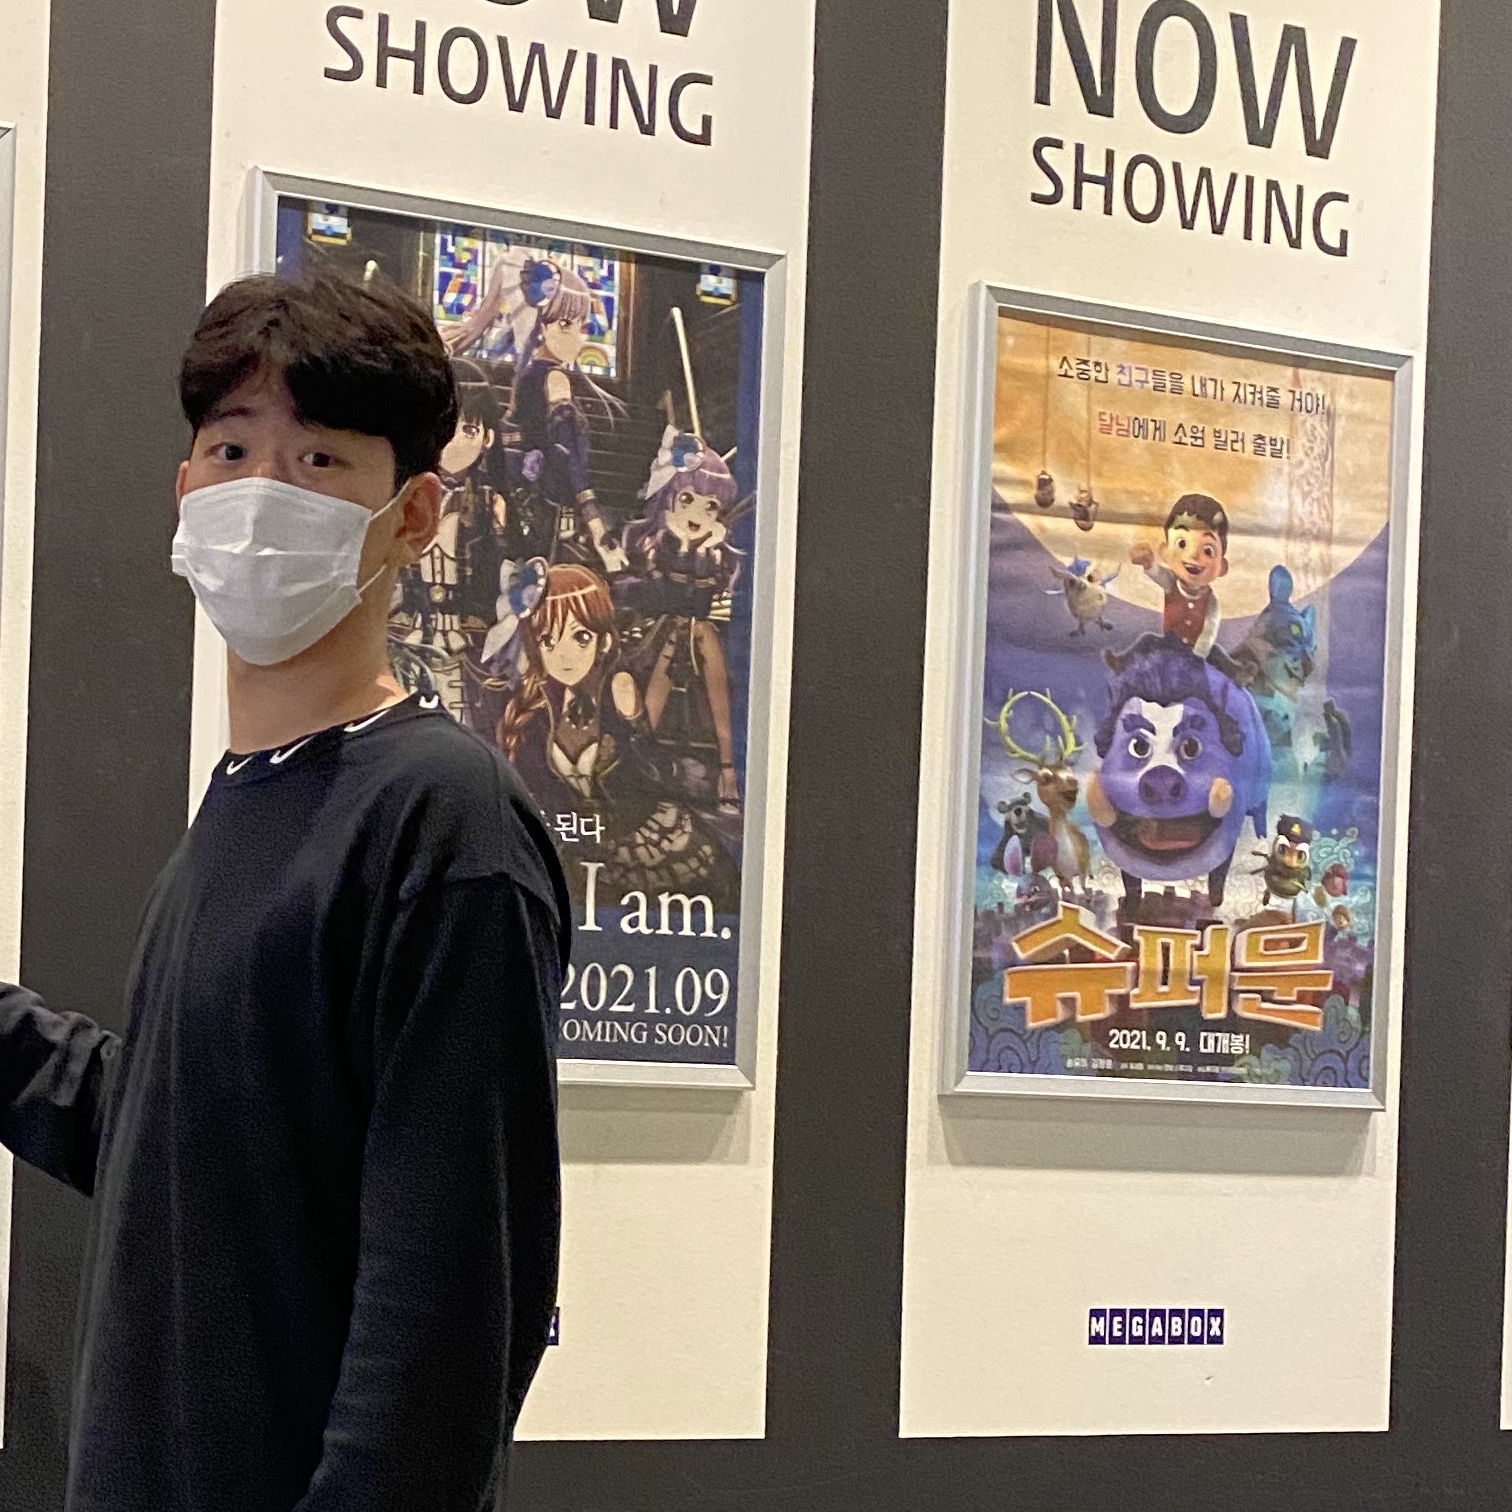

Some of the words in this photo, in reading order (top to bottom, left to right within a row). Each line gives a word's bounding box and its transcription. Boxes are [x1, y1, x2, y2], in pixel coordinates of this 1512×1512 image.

[324, 5, 714, 147] SHOWING
[1033, 0, 1357, 160] NOW
[1030, 136, 1350, 258] SHOWING
[1057, 355, 1110, 384] 소중한
[1116, 363, 1185, 395] 친구들을
[1191, 374, 1224, 401] 내가
[1232, 380, 1281, 410] 지켜줄
[1288, 388, 1326, 416] 거야!
[1098, 411, 1166, 443] 달님에게
[1172, 422, 1205, 449] 소원
[1213, 427, 1246, 454] 빌러
[1251, 433, 1291, 460] 출발!
[578, 861, 605, 932] I
[620, 890, 732, 940] am.
[1003, 901, 1334, 1032] 슈퍼문
[560, 1018, 648, 1044] OMING
[654, 1022, 728, 1048] SOON!
[1109, 1028, 1152, 1052] 2021.
[1199, 1031, 1250, 1055] 대개봉!
[1090, 1316, 1222, 1337] MEGABOX
